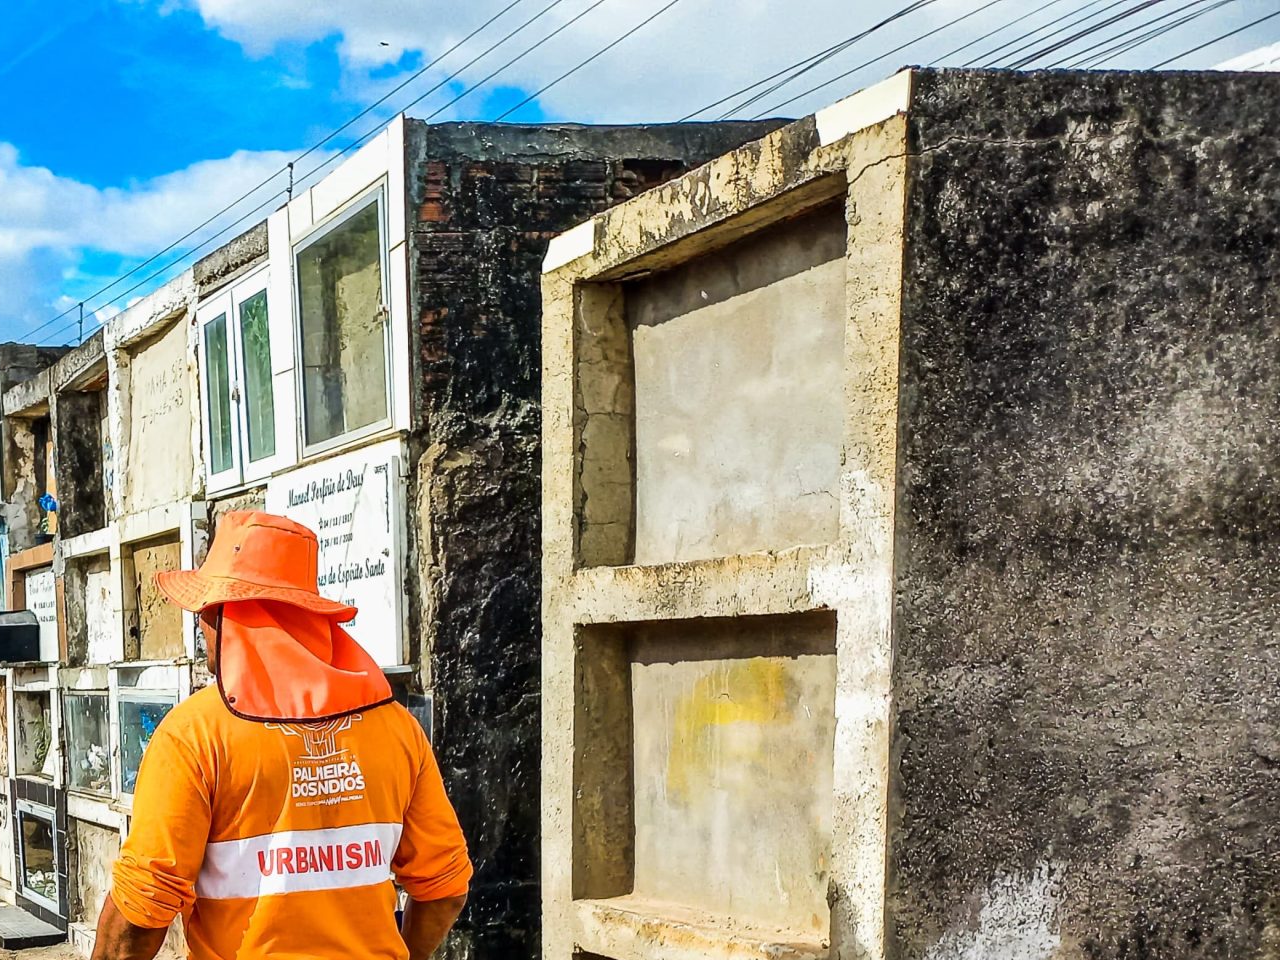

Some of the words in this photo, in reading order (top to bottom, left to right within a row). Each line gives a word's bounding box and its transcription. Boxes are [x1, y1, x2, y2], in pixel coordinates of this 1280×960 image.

[337, 472, 344, 493] de
[347, 469, 364, 490] Deus
[328, 565, 337, 584] de
[365, 557, 385, 578] Santo
[257, 839, 387, 876] URBANISM
